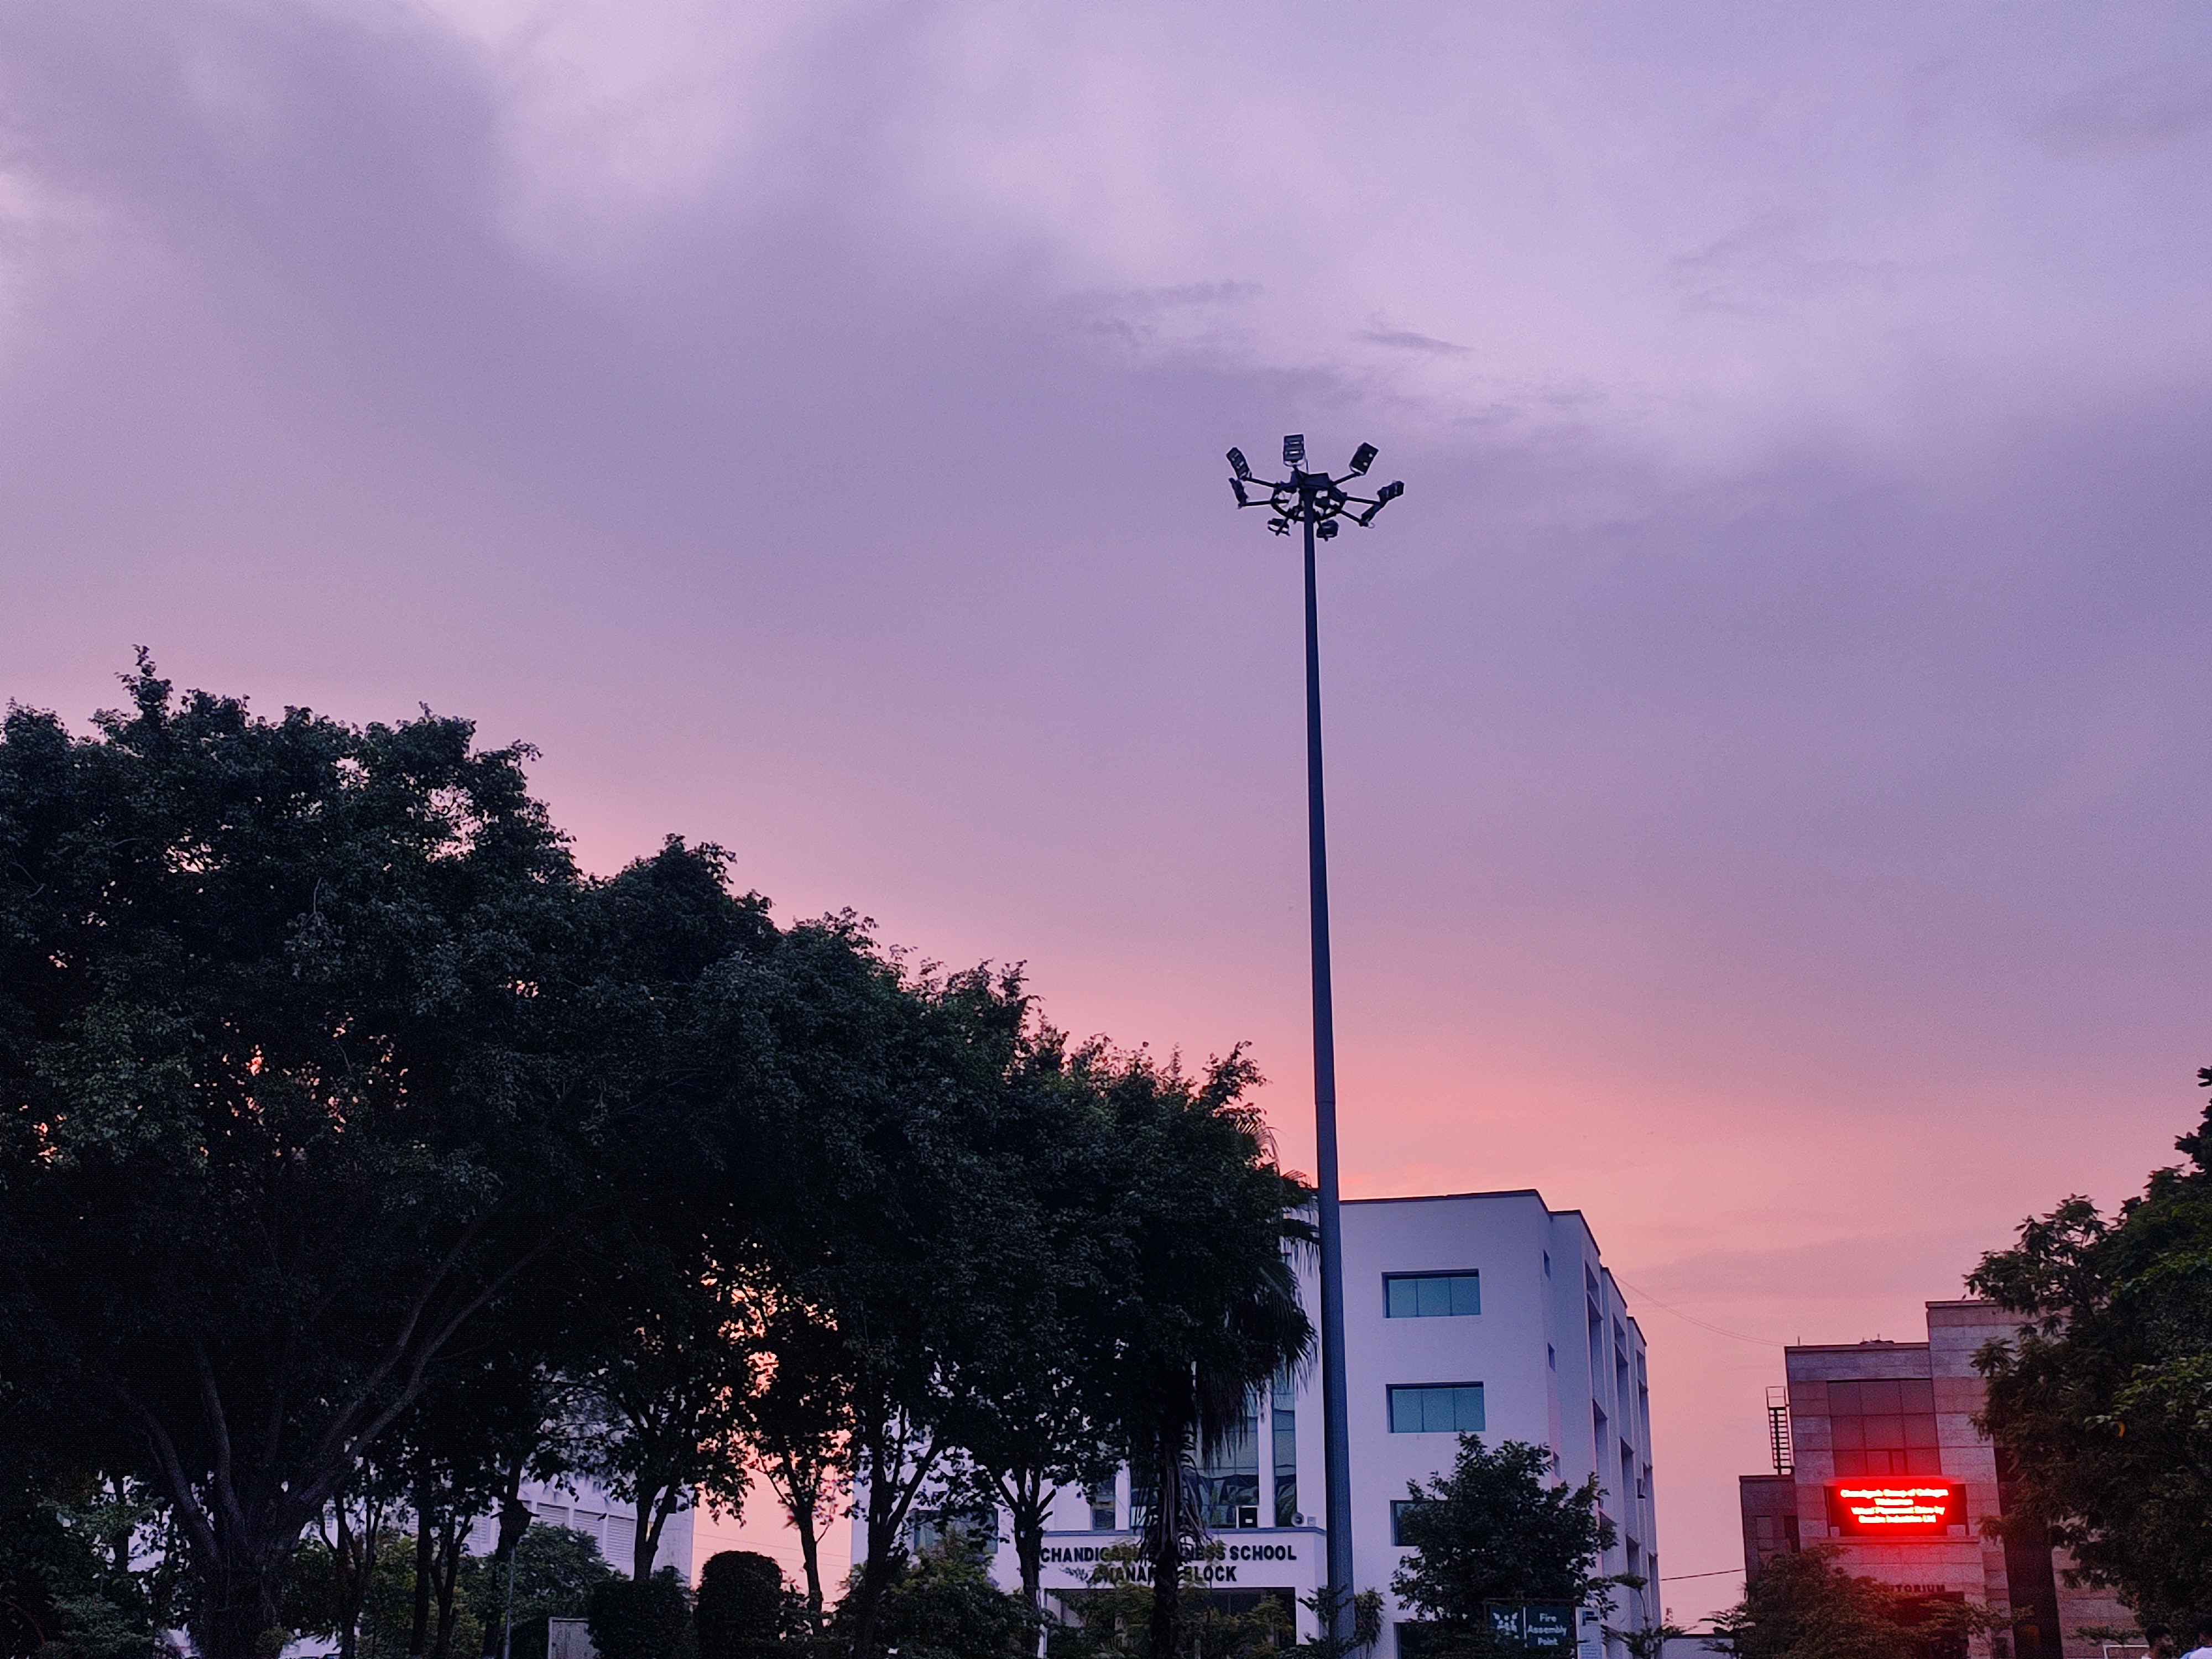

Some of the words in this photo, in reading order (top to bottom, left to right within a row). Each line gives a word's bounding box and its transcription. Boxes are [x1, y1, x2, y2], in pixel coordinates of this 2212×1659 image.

[1041, 1546, 1140, 1563] CHANDIG
[1229, 1545, 1297, 1561] SCHOOL
[1182, 1566, 1237, 1582] BLOCK
[1539, 1613, 1557, 1622] Fire
[1527, 1624, 1567, 1636] Assembly
